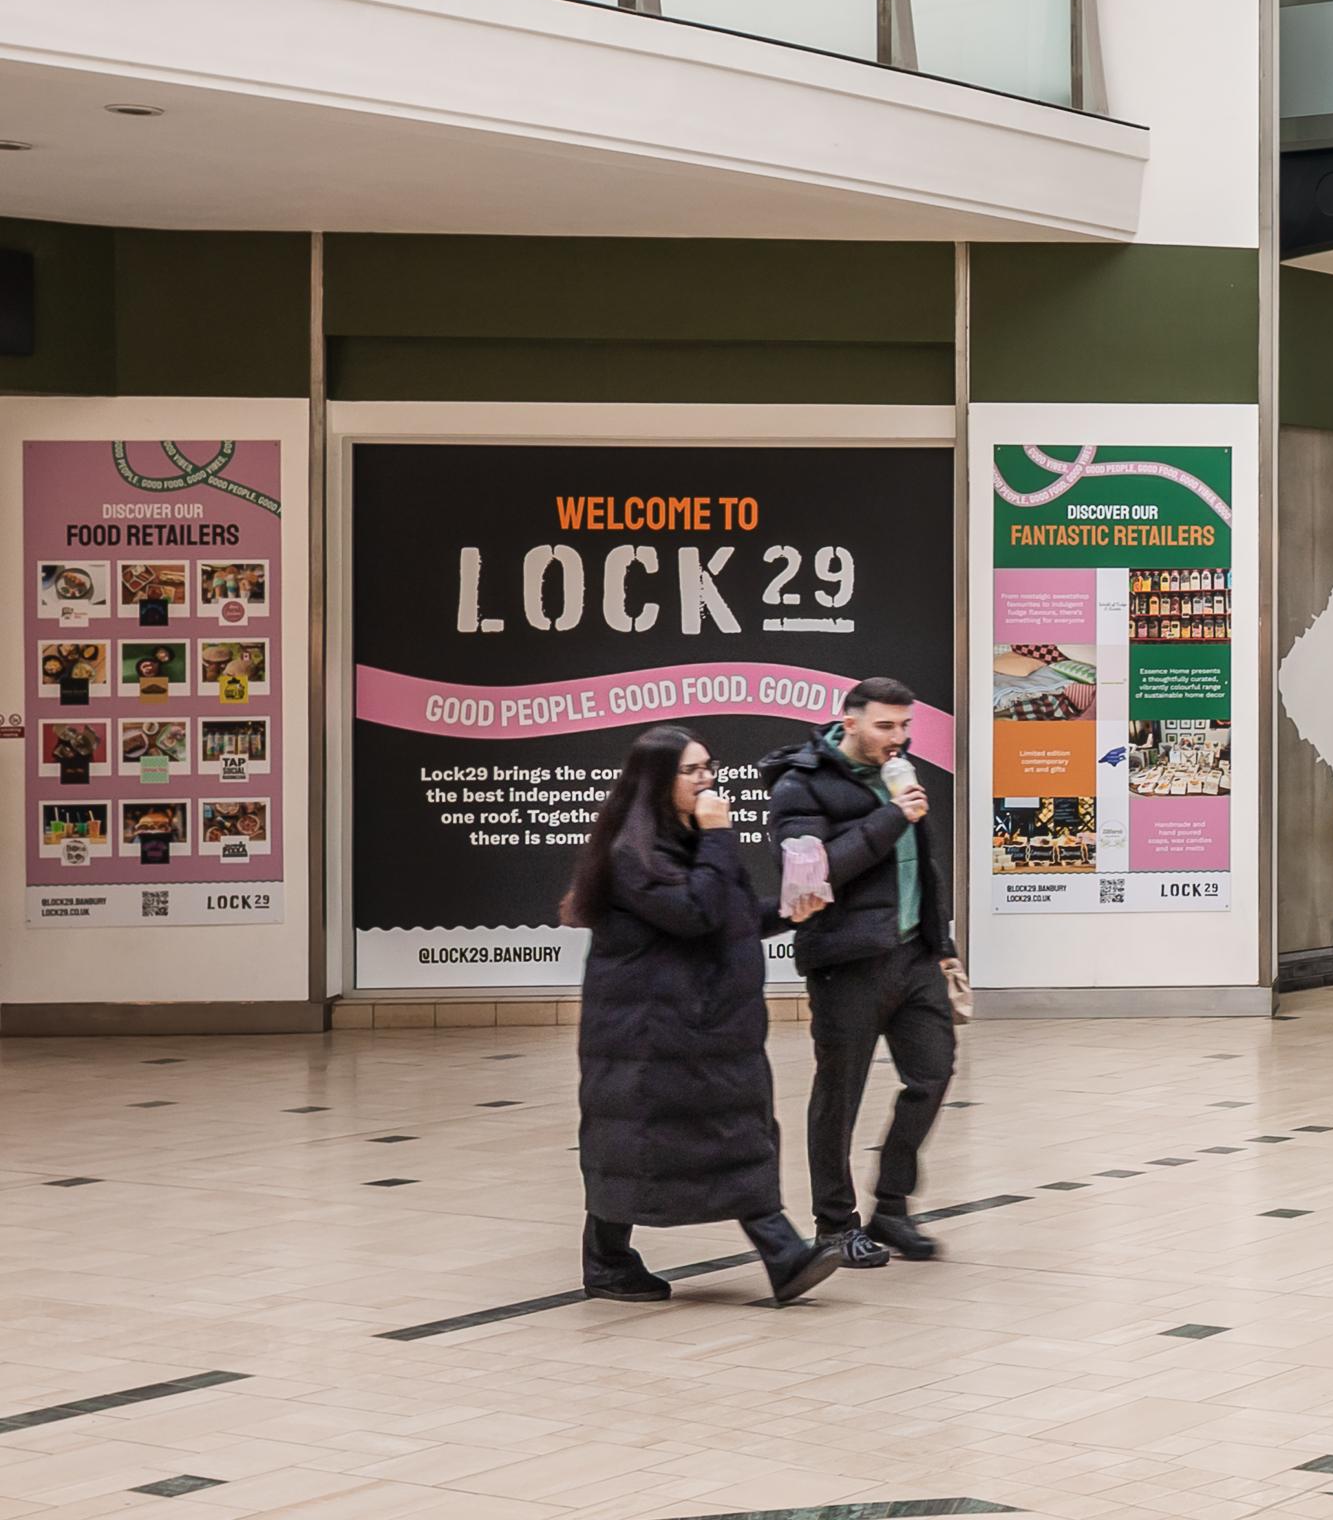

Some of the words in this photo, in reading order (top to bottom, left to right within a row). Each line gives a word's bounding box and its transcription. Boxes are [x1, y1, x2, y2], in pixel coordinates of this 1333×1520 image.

[102, 503, 172, 519] DISCOVER
[174, 503, 204, 519] OUR
[556, 495, 712, 530] WELCOME
[718, 496, 759, 530] TO
[1067, 505, 1129, 520] DISCOVER
[1131, 505, 1159, 520] OUR
[66, 524, 120, 546] FOOD
[127, 524, 240, 546] RETAILERS
[1010, 524, 1110, 546] FANTASTIC
[1113, 525, 1215, 547] RETAILERS
[456, 544, 742, 635] LOCK
[762, 545, 855, 608] 29
[1147, 676, 1189, 684] thoughtfully
[425, 694, 494, 727] GOOD
[501, 690, 605, 727] PEOPLE.
[608, 679, 677, 715] GOOD
[681, 675, 753, 705] FOOD.
[758, 676, 826, 711] GOOD
[222, 758, 246, 766] TAP
[420, 766, 488, 781] Lock29
[493, 766, 551, 784] brings
[555, 766, 586, 781] the
[426, 788, 458, 803] the
[462, 788, 505, 803] best
[441, 812, 475, 824] one
[480, 809, 523, 824] roof.
[527, 808, 600, 827] Togethe
[469, 831, 520, 845] there
[524, 830, 541, 845] is
[1006, 885, 1067, 893] @LOCK29.BANBURY
[1160, 883, 1202, 897] LOCK
[1204, 883, 1219, 893] 29
[207, 895, 252, 910] LOCK
[255, 894, 270, 905] 29
[1006, 895, 1052, 903] LOCK29.CO.UK
[418, 945, 561, 965] @LOCK29.BANBURY
